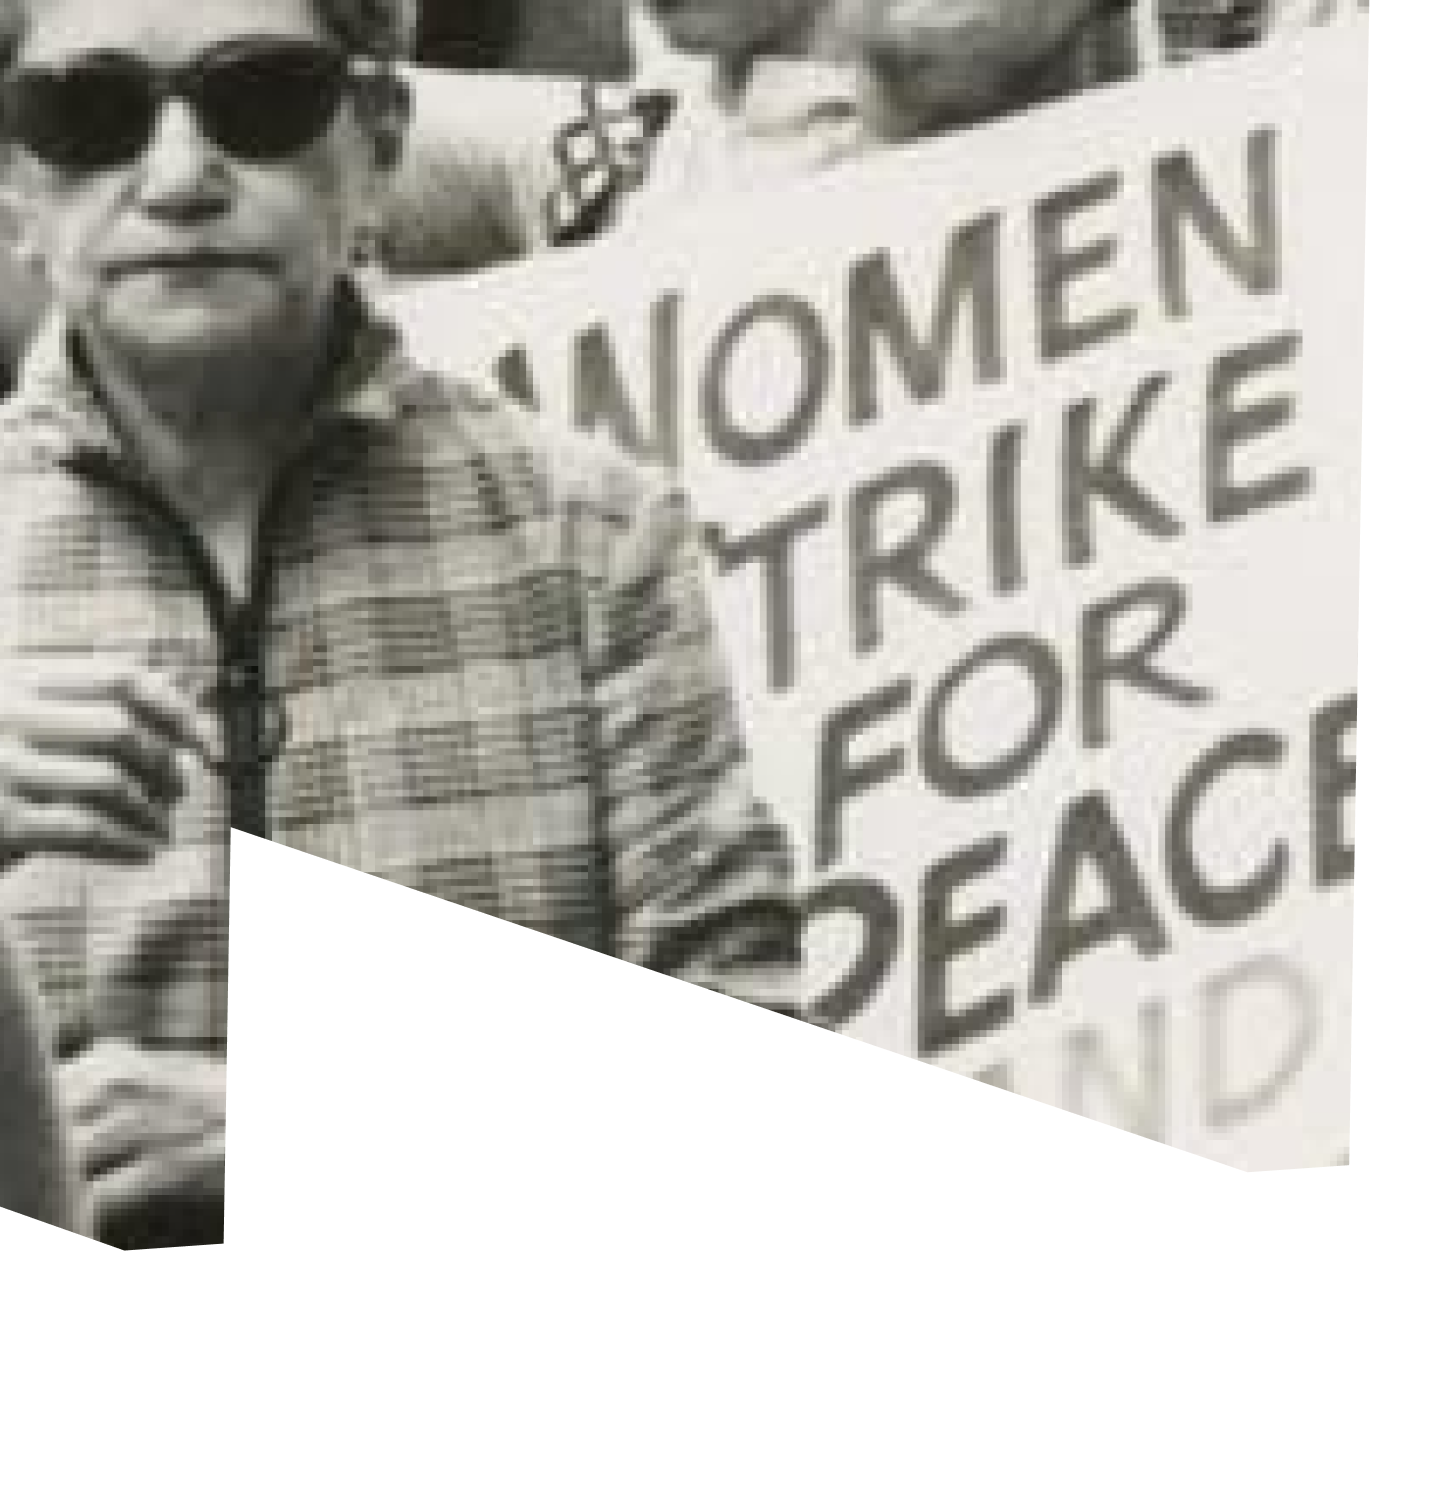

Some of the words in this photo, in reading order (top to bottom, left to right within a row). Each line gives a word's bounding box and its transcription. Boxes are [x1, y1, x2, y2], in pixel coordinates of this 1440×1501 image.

[703, 331, 1312, 695] TRIKE
[815, 577, 1215, 872] FOR
[970, 954, 1325, 1141] ND
